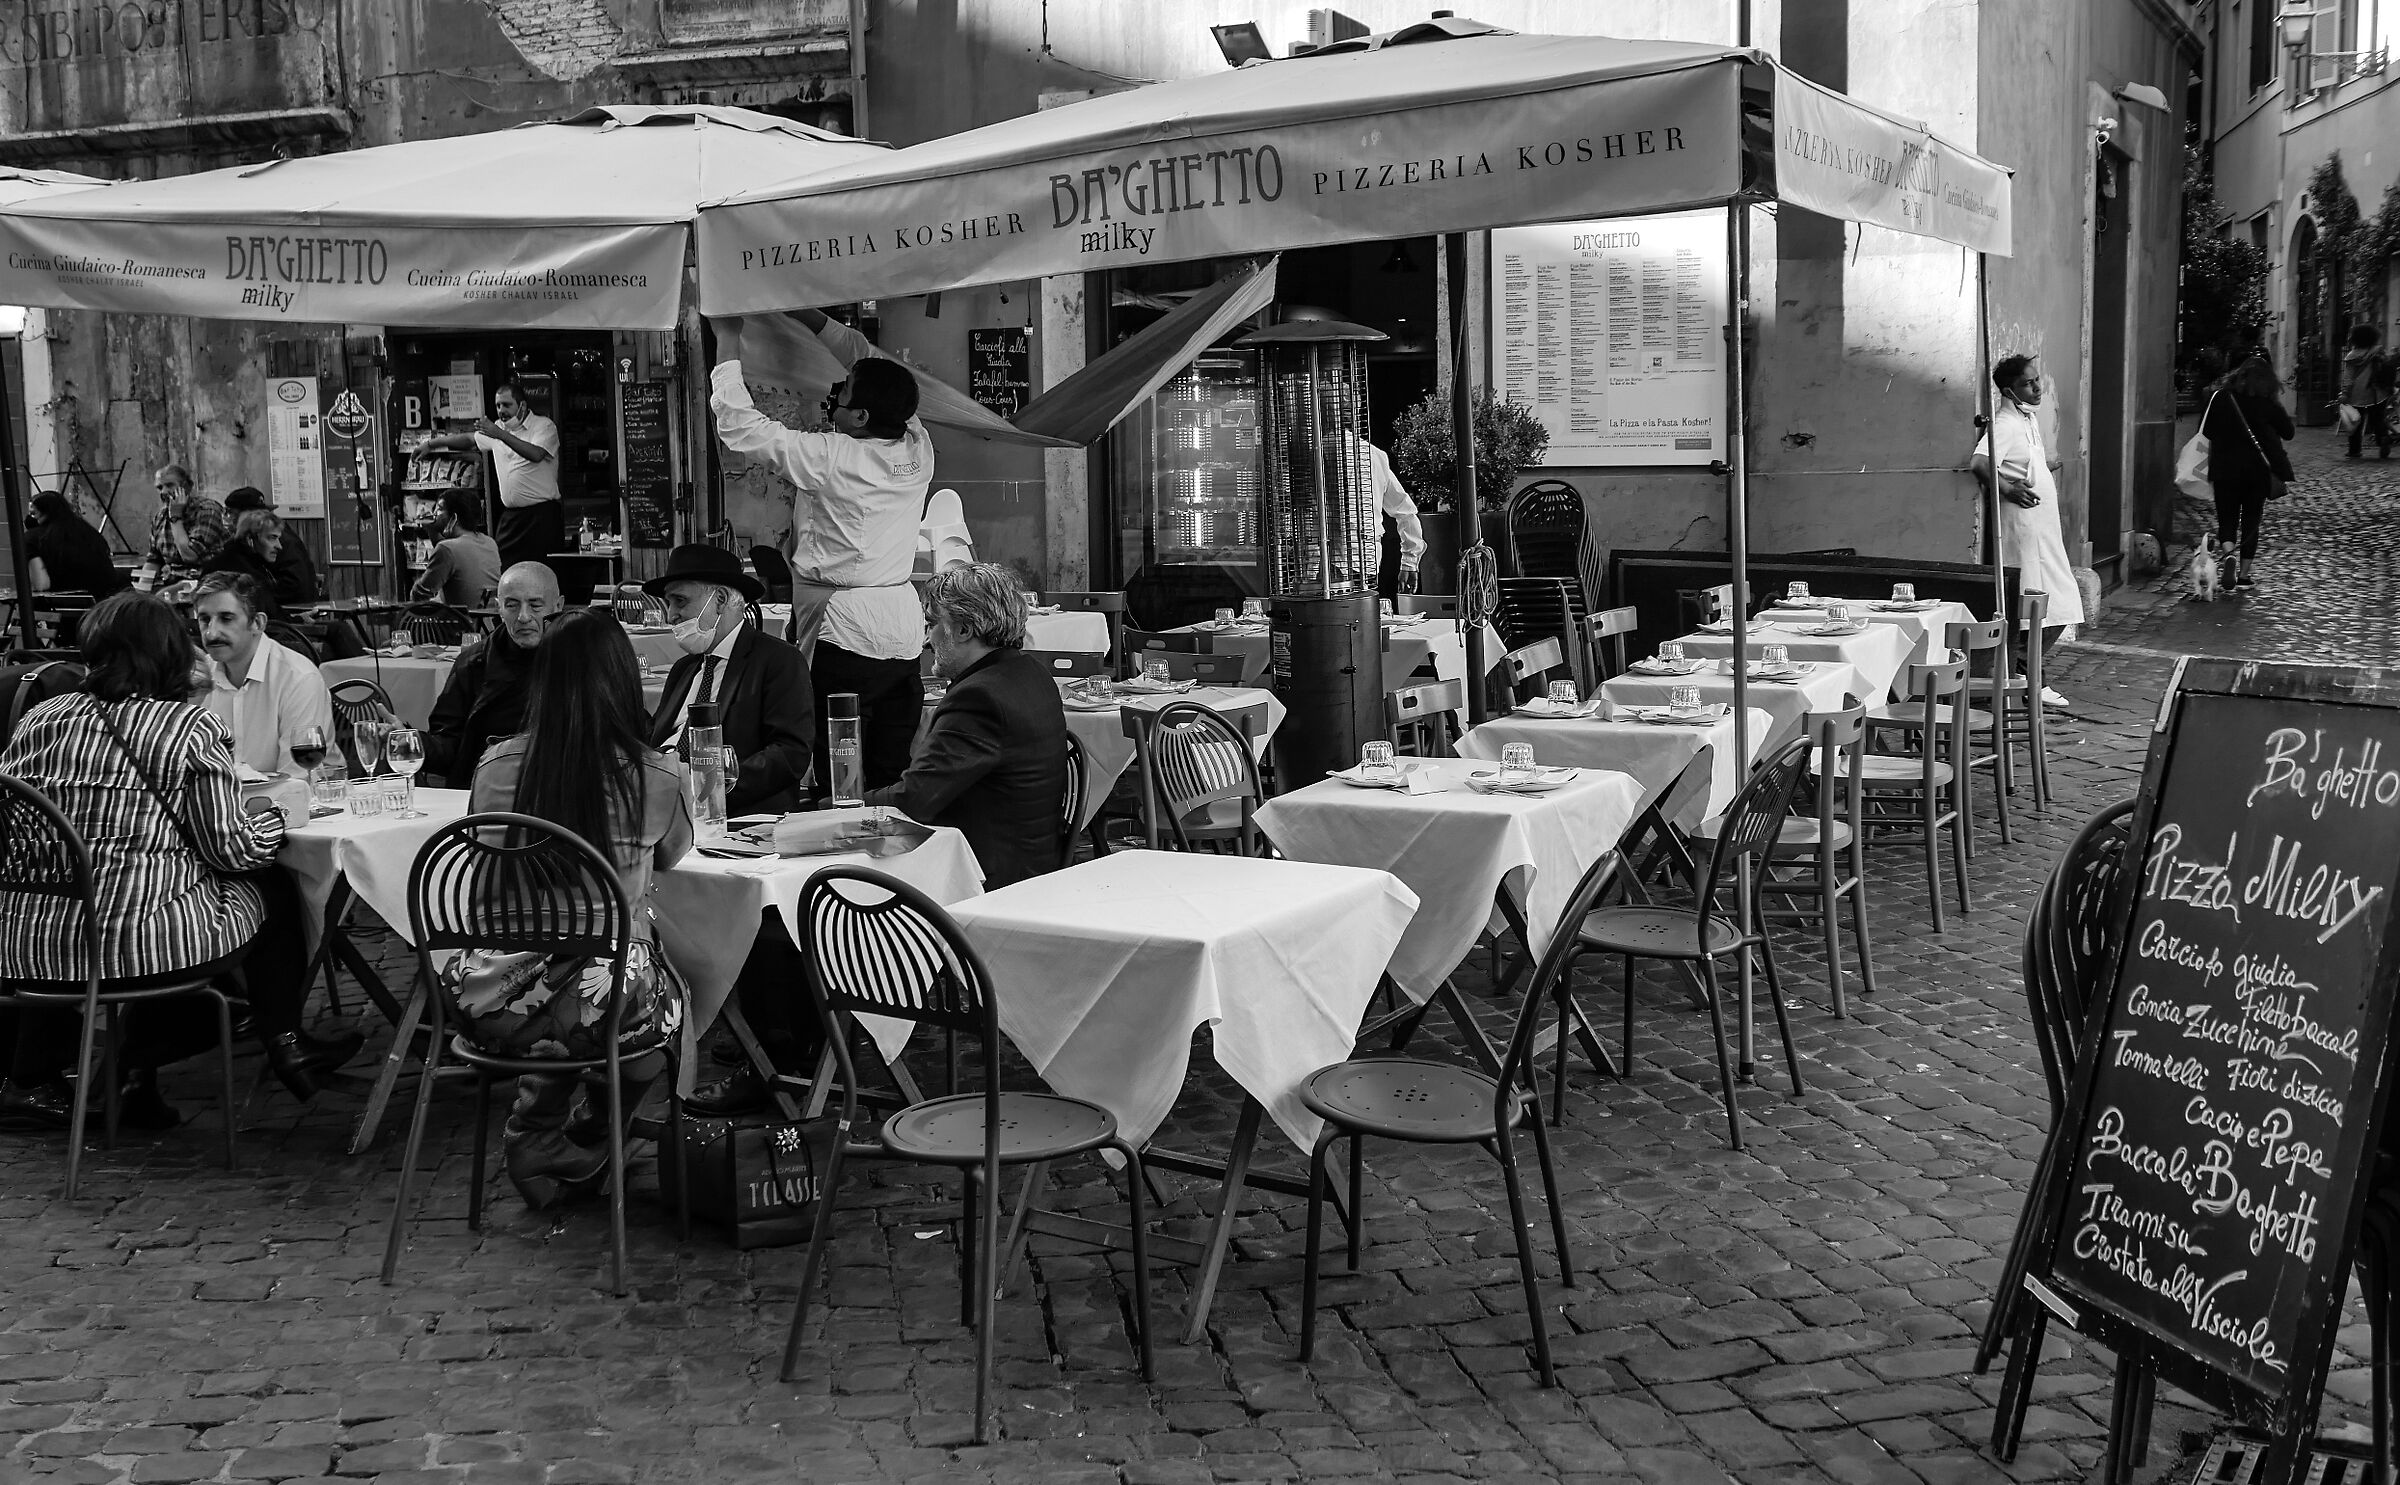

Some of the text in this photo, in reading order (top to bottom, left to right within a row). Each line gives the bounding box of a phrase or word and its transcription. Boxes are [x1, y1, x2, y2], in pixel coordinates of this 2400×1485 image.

[1312, 125, 1686, 195] PIZZERIA KOSHER
[1048, 143, 1284, 230] BA'GHETTO
[740, 211, 1027, 271] PIZZERIA KOSHER
[1080, 222, 1156, 256] milky
[1572, 231, 1641, 251] BA'GHETTO
[1581, 249, 1604, 259] milky
[8, 252, 207, 280] Cucina Giudaico-Romanesca
[225, 235, 389, 286] BA'GHETTO
[406, 268, 648, 288] Cucina Giudaico-Romanesca
[241, 283, 296, 313] milky
[463, 290, 498, 299] KOSHER
[542, 291, 580, 300] ISRAEL
[1609, 419, 1619, 428] La
[1620, 418, 1640, 428] Pizza
[1657, 418, 1679, 427] Pasta
[2139, 919, 2224, 988] Carciofo
[2227, 1057, 2278, 1093] Fiori
